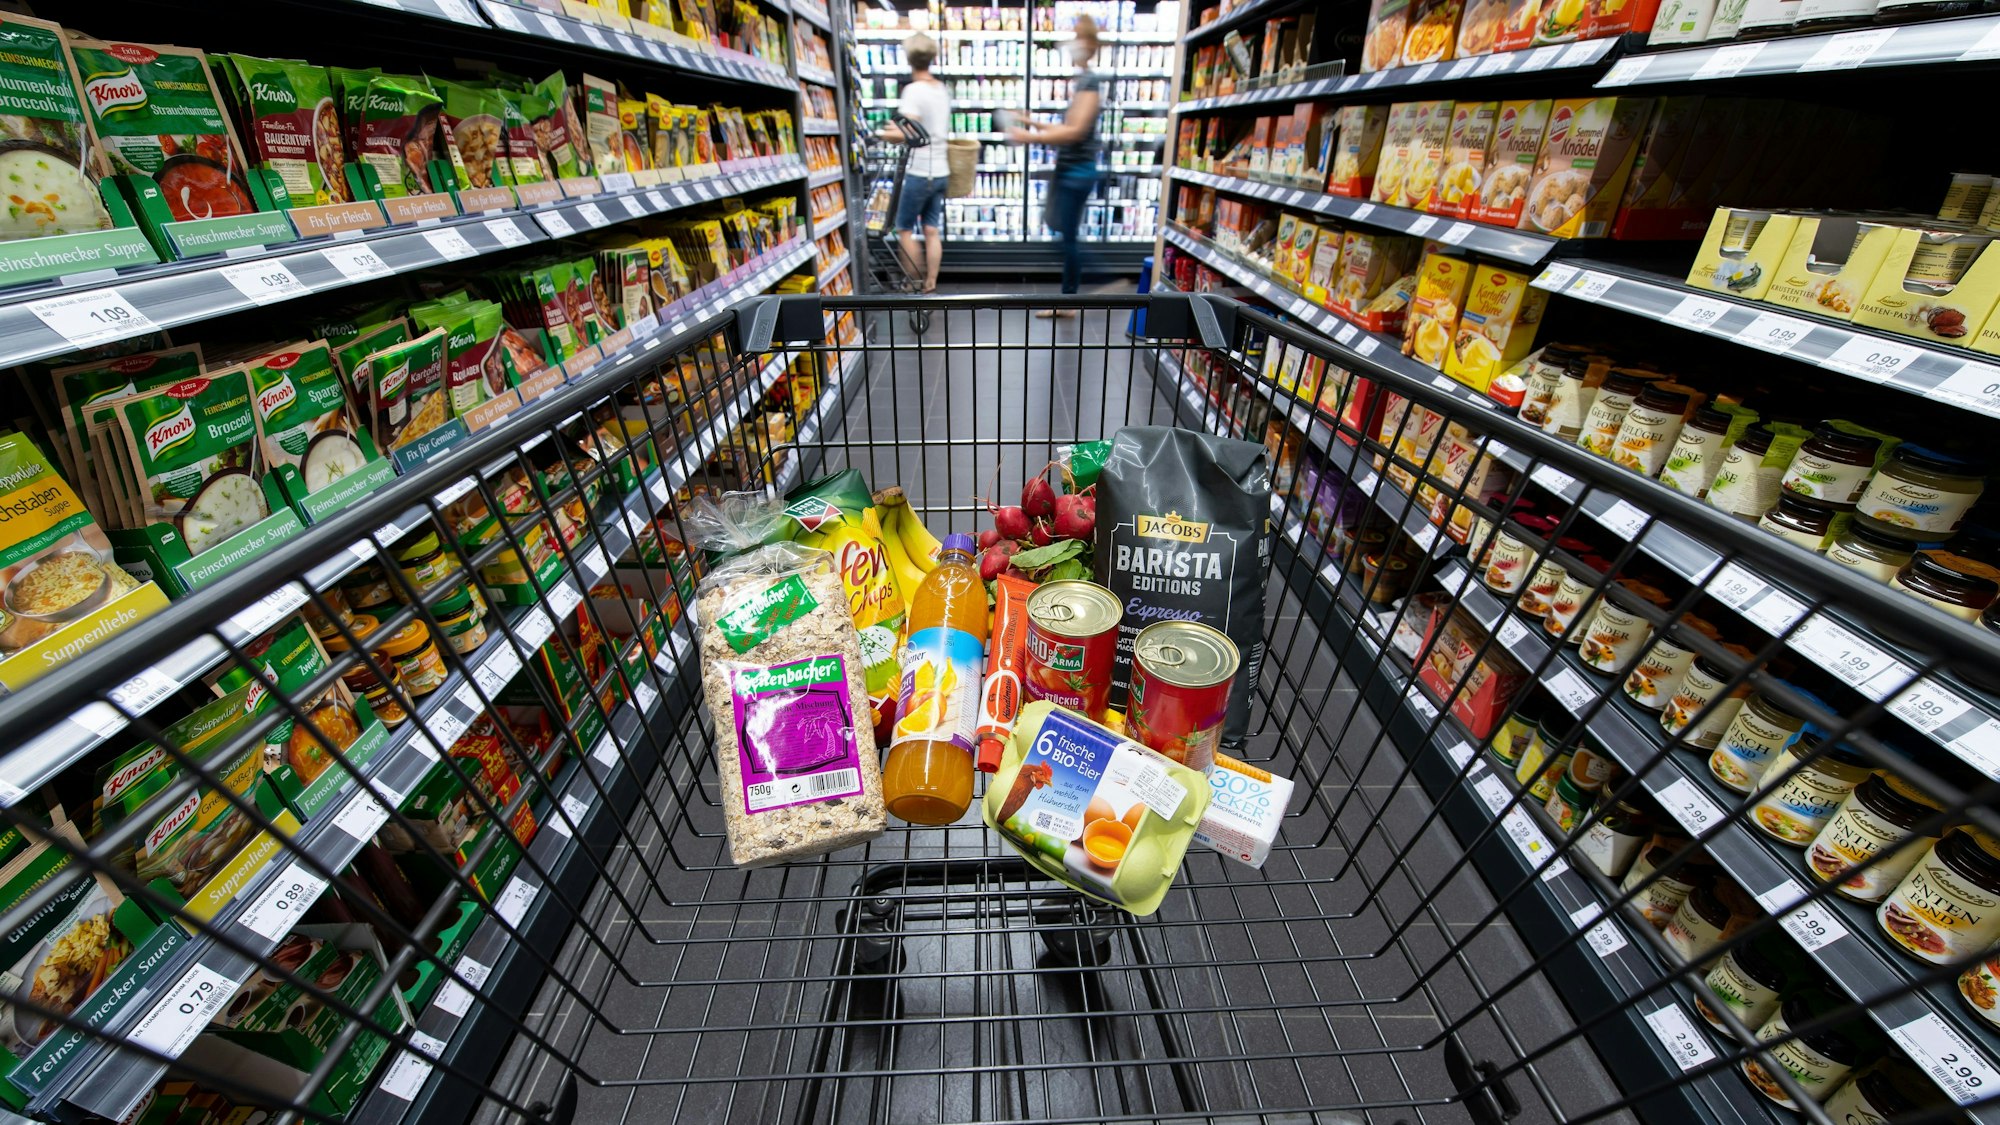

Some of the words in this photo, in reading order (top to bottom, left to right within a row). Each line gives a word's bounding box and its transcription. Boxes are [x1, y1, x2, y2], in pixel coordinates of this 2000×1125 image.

[89, 82, 142, 105] Knorr
[154, 80, 209, 92] FEINSCHMECKER
[252, 82, 296, 104] Knorr
[150, 104, 219, 117] Strauchtomaten
[264, 132, 312, 147] BAUERNTOPF
[1421, 129, 1443, 149] Püree
[1460, 134, 1485, 149] Knödel
[1576, 126, 1603, 138] Semmel
[1507, 136, 1538, 153] Knödel
[1560, 137, 1601, 156] Knödel
[399, 205, 412, 217] Fix
[412, 202, 424, 217] für
[423, 199, 447, 214] Fleisch
[308, 215, 325, 228] Fix
[325, 212, 341, 230] für
[341, 209, 373, 223] Fleisch
[178, 224, 256, 247] Feinschmecker
[257, 222, 288, 239] Suppe
[0, 244, 102, 273] einschmecker
[104, 240, 148, 260] Suppe
[353, 254, 377, 267] 0.79
[261, 272, 290, 287] 0.99
[1476, 283, 1511, 305] Kartoffel
[1781, 294, 1800, 304] PASTE
[90, 306, 131, 324] 1.09
[1479, 298, 1503, 316] Püree
[1692, 308, 1716, 320] 0.99
[1859, 303, 1920, 323] BRATEN-PASTE
[448, 335, 476, 349] Knorr
[1768, 328, 1797, 341] 0.99
[1866, 352, 1901, 368] 0.99
[180, 382, 197, 392] Extra
[382, 367, 408, 390] Knorr
[258, 383, 294, 412] Knorr
[474, 411, 485, 424] Fix
[485, 407, 495, 421] für
[494, 399, 513, 417] Fleisch
[148, 417, 192, 449] Knorr
[207, 409, 252, 438] Broccoli
[405, 448, 418, 462] Fix
[418, 441, 431, 458] für
[430, 427, 457, 446] Gemüse
[1812, 470, 1837, 482] FOND
[310, 480, 367, 516] Feinschmecker
[367, 466, 391, 484] Suppe
[1880, 490, 1907, 505] FISCH
[1910, 500, 1939, 512] FOND
[44, 500, 71, 517] Suppe
[6, 549, 21, 561] mit
[22, 538, 43, 555] vielen
[60, 524, 71, 533] von
[70, 517, 85, 529] A-Z
[1142, 520, 1202, 539] JACOBS
[190, 536, 266, 583] Feinschmecker
[267, 517, 297, 541] Suppe
[1116, 545, 1222, 580] BARISTA
[1132, 576, 1202, 596] EDITIONS
[1722, 578, 1748, 596] 1.99
[850, 581, 893, 617] Chips
[1126, 597, 1203, 622] Espresso
[41, 606, 138, 667] Suppenliebe
[1503, 626, 1518, 640] 2.99
[1115, 656, 1131, 665] FLAT
[1839, 650, 1871, 671] 1.99
[481, 672, 497, 689] 1.79
[1930, 686, 1945, 697] FOND
[795, 700, 834, 710] Mischung
[1044, 692, 1079, 706] STÜCKIG
[1568, 689, 1586, 706] 2.99
[1907, 693, 1944, 717] 1.99
[439, 715, 457, 734] 1.79
[362, 730, 385, 754] Suppe
[1036, 729, 1058, 756] 6
[1057, 735, 1096, 762] frische
[1727, 735, 1757, 760] FOND
[1730, 722, 1772, 755] FISCH
[105, 749, 164, 797] Knorr
[1051, 748, 1101, 781] BIO-Eier
[1053, 788, 1079, 801] mobilen
[1075, 784, 1090, 793] dem
[1210, 770, 1273, 807] 30%
[1781, 778, 1841, 811] FISCH
[568, 800, 581, 815] 1.29
[1684, 802, 1708, 824] 2.99
[1782, 793, 1824, 816] FOND
[148, 797, 199, 848] Knorr
[515, 814, 534, 839] Pack
[1515, 821, 1530, 838] 0.59
[208, 833, 278, 906] Suppenliebe
[493, 854, 511, 881] Soße
[69, 877, 91, 900] Sauce
[276, 882, 305, 910] 0.89
[515, 882, 530, 900] 1.29
[1911, 872, 1983, 926] ENTEN
[1910, 892, 1956, 926] FOND
[1794, 910, 1826, 937] 2.99
[1594, 926, 1613, 946] 2.99
[136, 933, 178, 975] Sauce
[142, 997, 175, 1029] CHAMPIGNON
[171, 984, 187, 1000] RAHM
[183, 968, 200, 986] SAUCE
[178, 981, 214, 1015] 0.79
[1676, 1032, 1700, 1058] 2.99
[1941, 1026, 1971, 1054] KALBS-FOND
[1971, 1051, 1988, 1070] 400ML
[1941, 1052, 1984, 1089] 2.99
